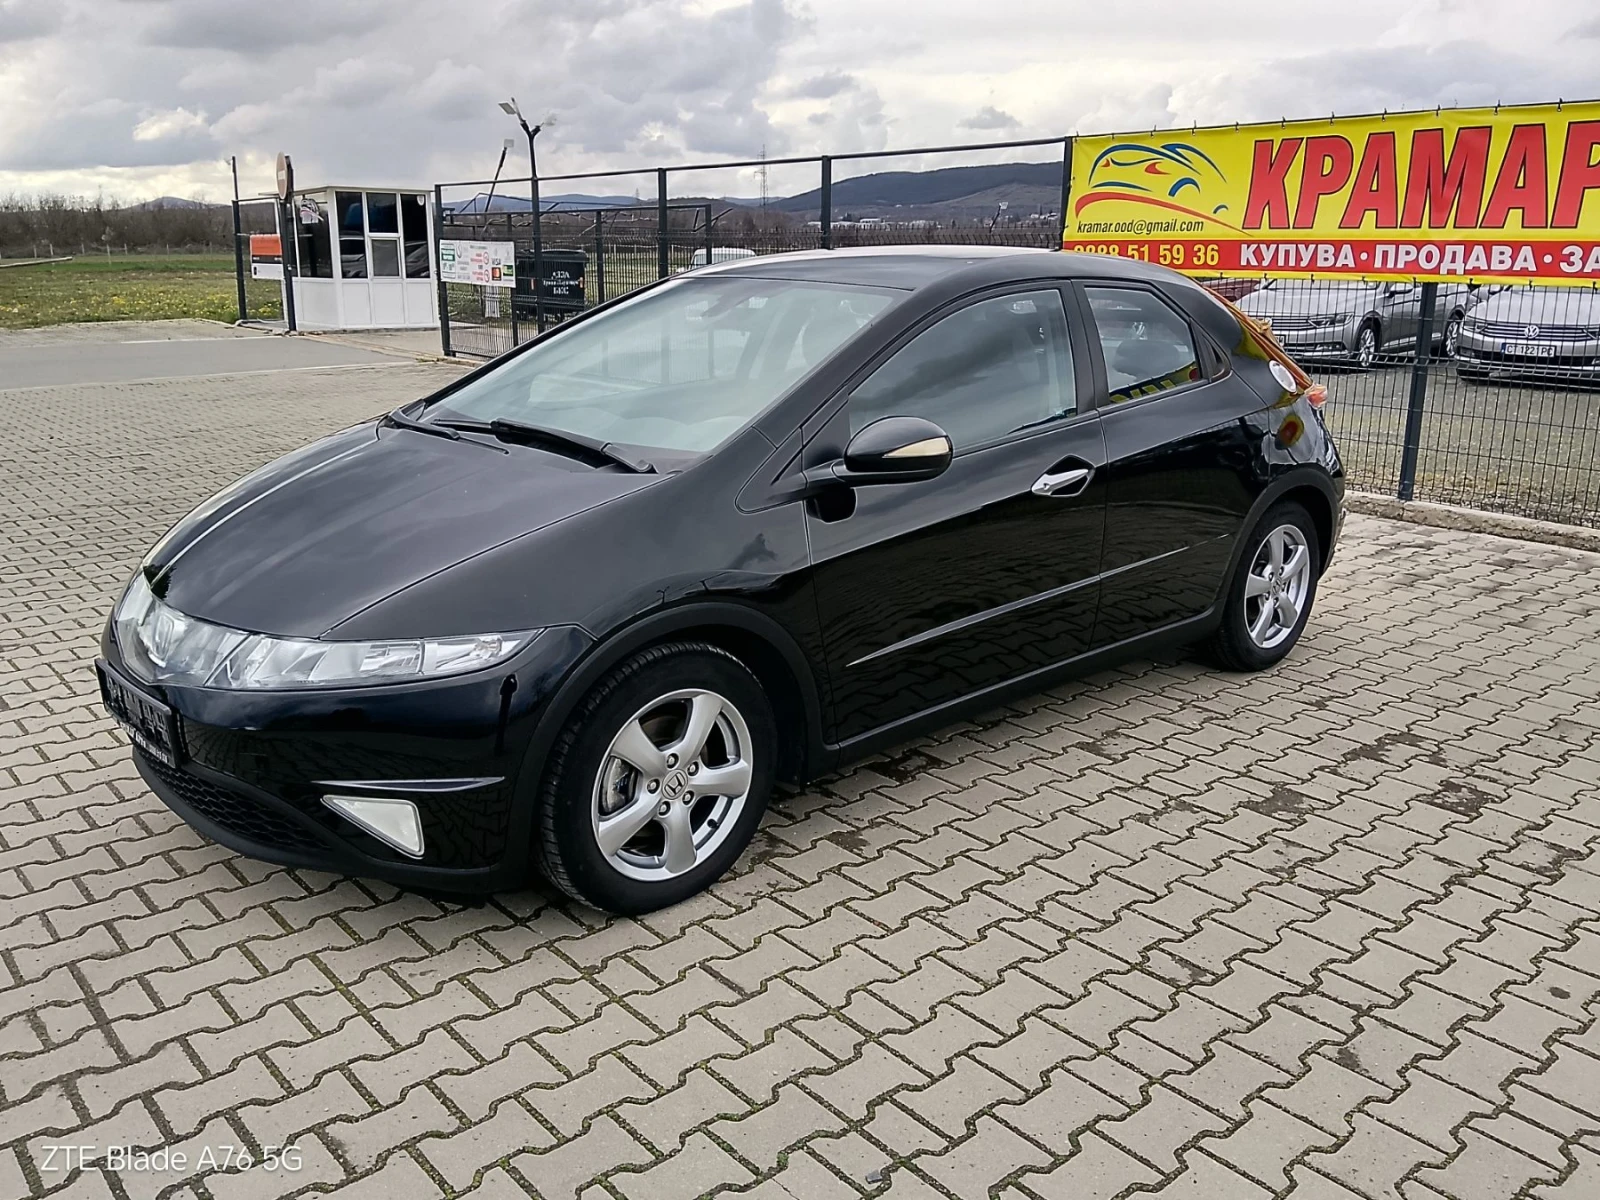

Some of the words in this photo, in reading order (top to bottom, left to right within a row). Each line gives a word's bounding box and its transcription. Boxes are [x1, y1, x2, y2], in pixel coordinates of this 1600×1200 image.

[1241, 119, 1600, 230] КРАМАР
[1077, 219, 1204, 235] kramar.ood@gmail.com
[1159, 244, 1184, 265] 59
[1193, 244, 1219, 265] 36
[1240, 243, 1356, 268] КУПУВА
[1374, 245, 1537, 275] ПРОДАВА
